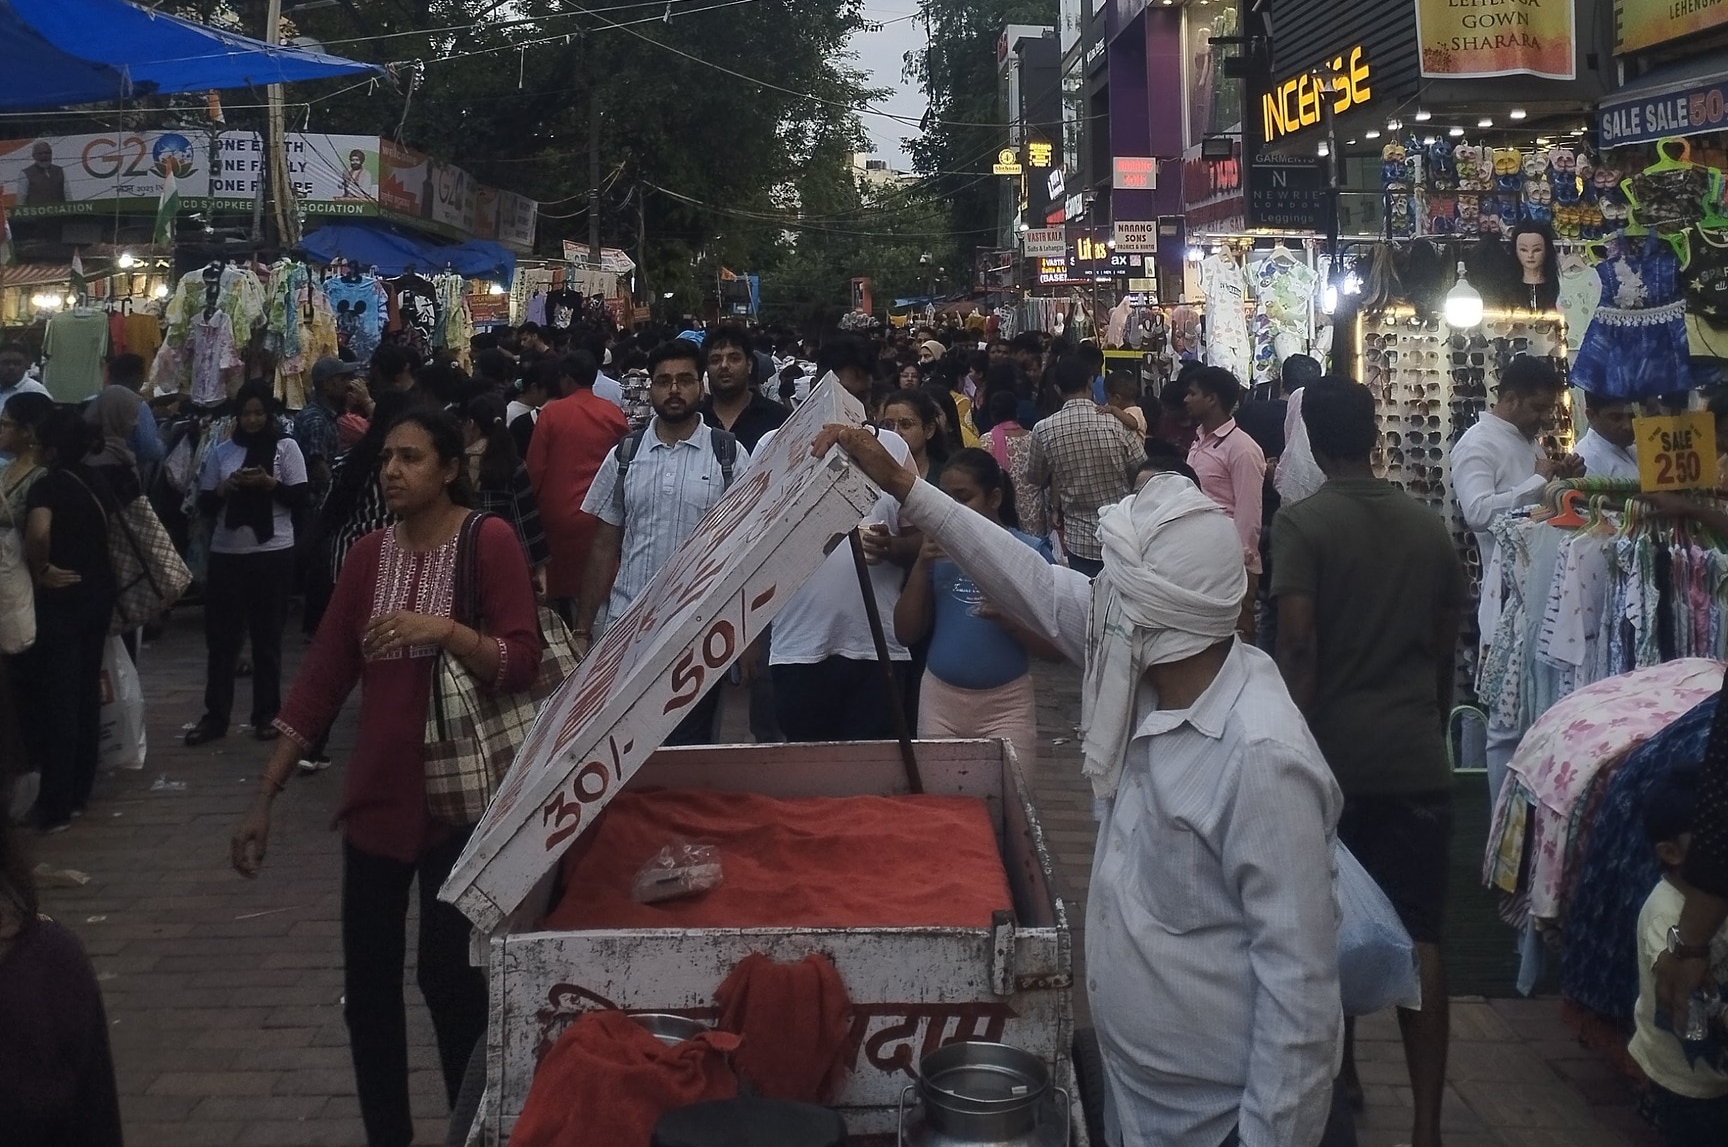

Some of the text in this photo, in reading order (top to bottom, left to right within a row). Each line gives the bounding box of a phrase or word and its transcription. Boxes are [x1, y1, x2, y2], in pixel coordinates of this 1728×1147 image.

[1461, 11, 1529, 29] GOWN
[1451, 33, 1541, 51] SHARARA
[1603, 105, 1641, 140] SALE
[1646, 96, 1688, 132] SALE
[251, 140, 304, 153] ETH
[214, 180, 246, 191] ONE
[1123, 173, 1147, 186] SONS
[1272, 170, 1287, 188] N
[14, 202, 94, 217] ASSOCIATION
[1260, 212, 1315, 224] Leggings
[1048, 231, 1063, 242] KALA
[1118, 224, 1153, 233] NARANG
[1124, 234, 1147, 243] SONS
[1660, 429, 1693, 452] SALE
[1654, 450, 1701, 485] 250
[662, 583, 777, 717] 50/-
[542, 735, 635, 852] 30/-
